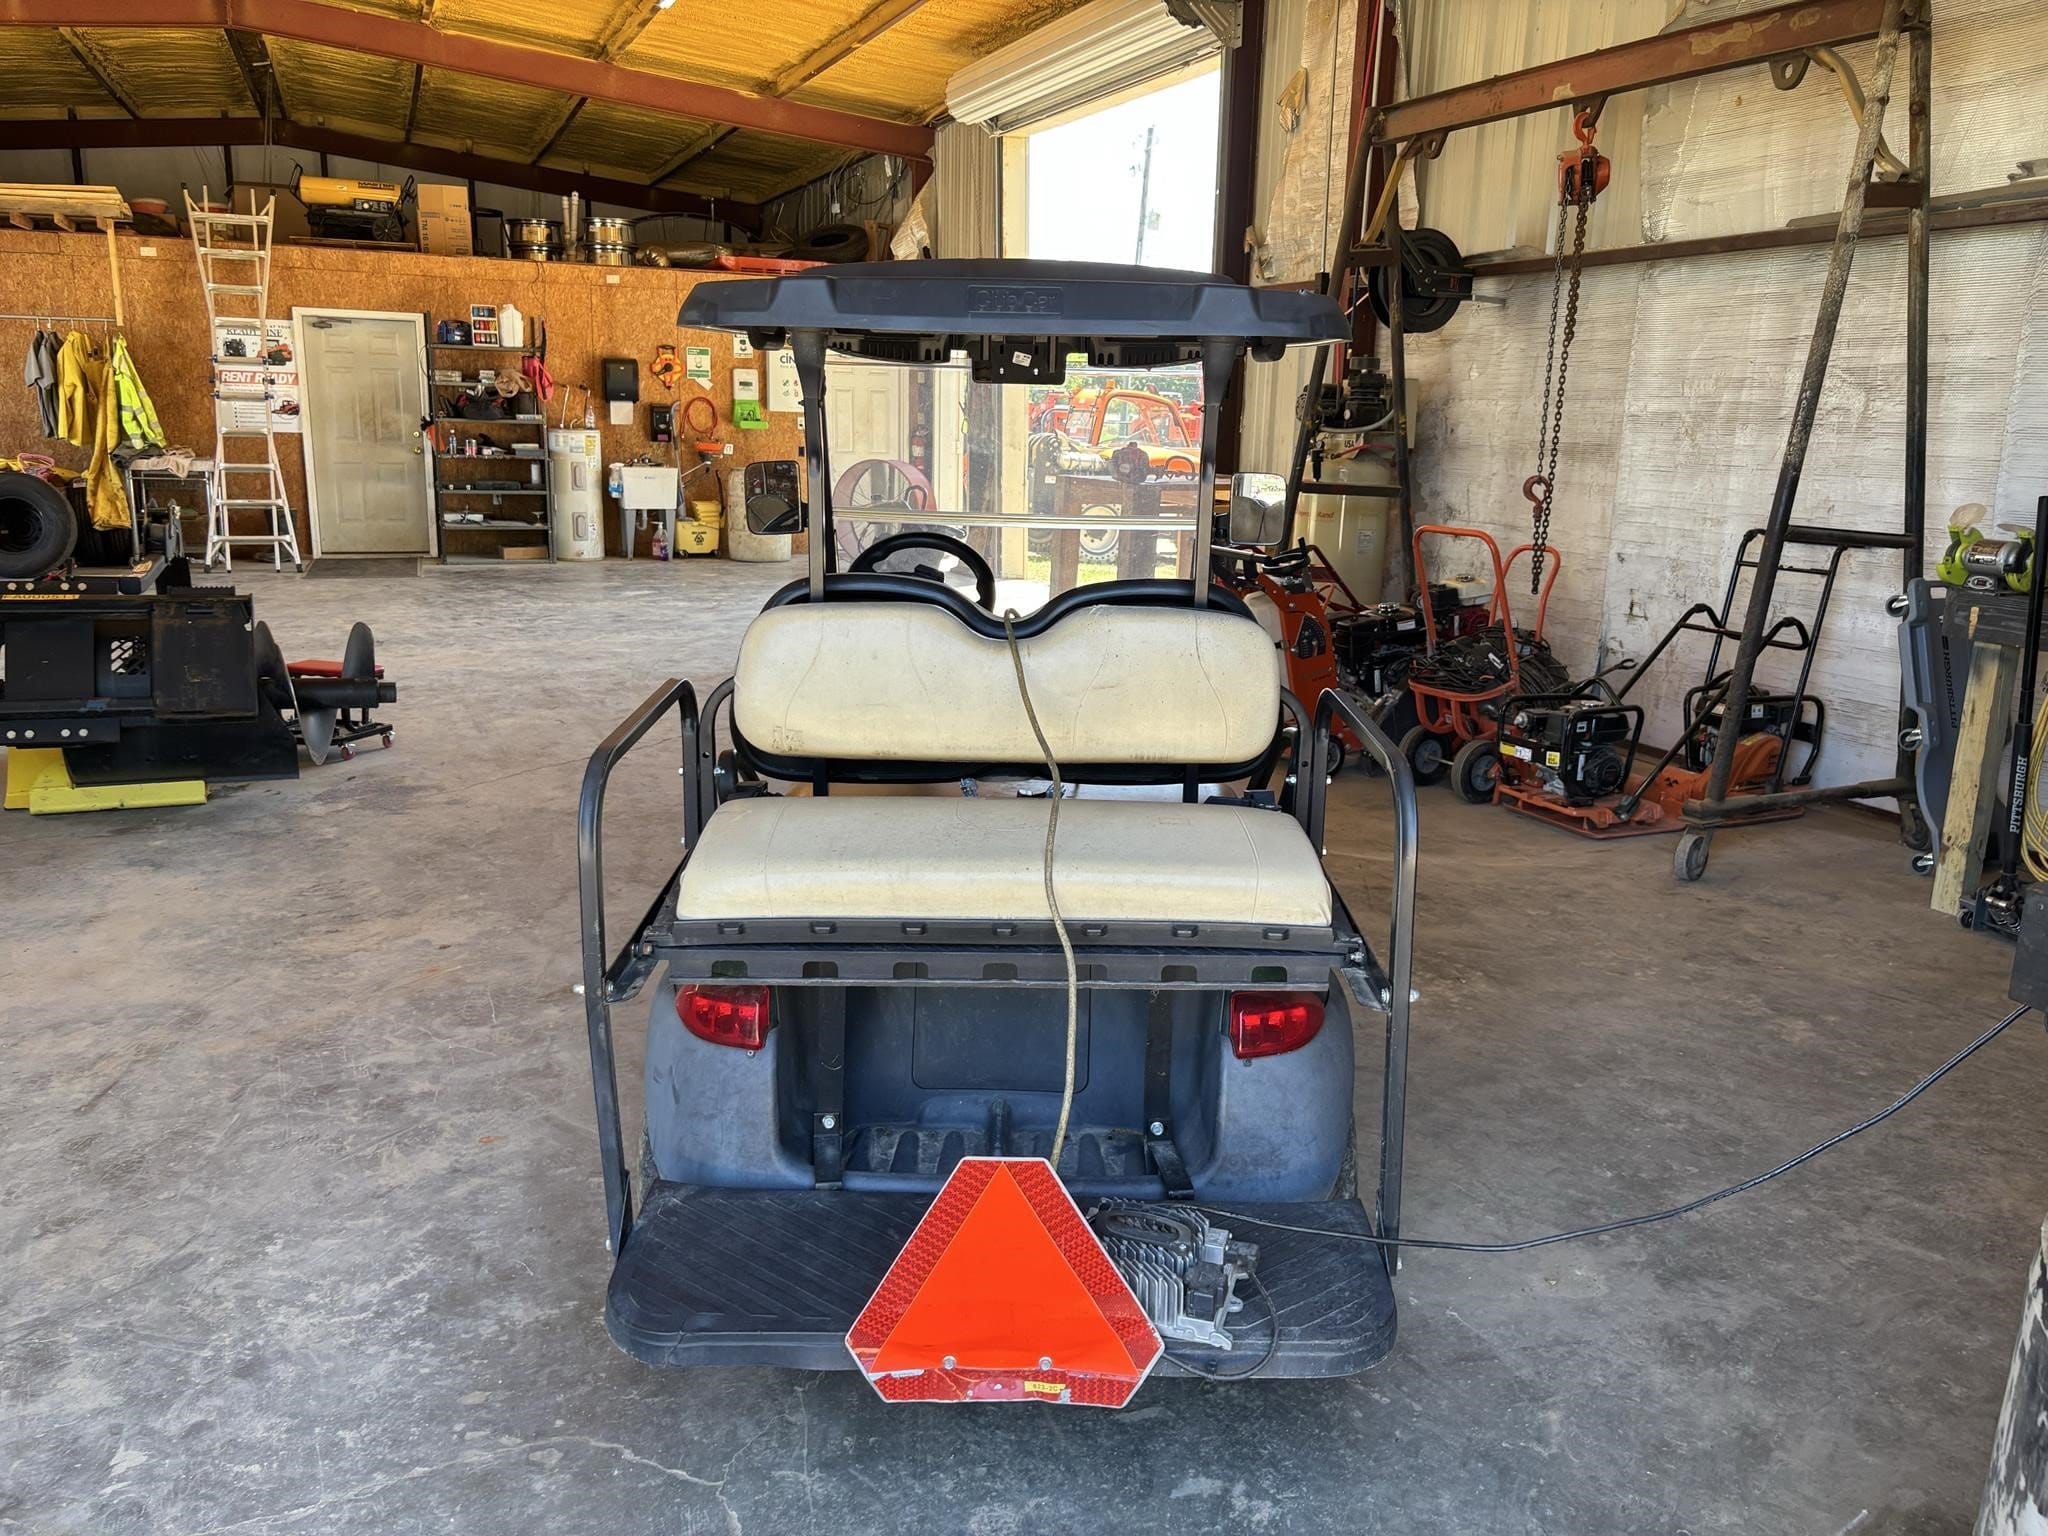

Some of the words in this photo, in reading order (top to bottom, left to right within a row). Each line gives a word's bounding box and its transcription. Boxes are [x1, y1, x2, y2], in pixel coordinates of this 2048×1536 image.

[221, 371, 254, 383] RENT
[1344, 440, 1354, 448] USA
[1943, 651, 1957, 729] PITTSBURGH
[2009, 754, 2028, 834] PITTSBURGH
